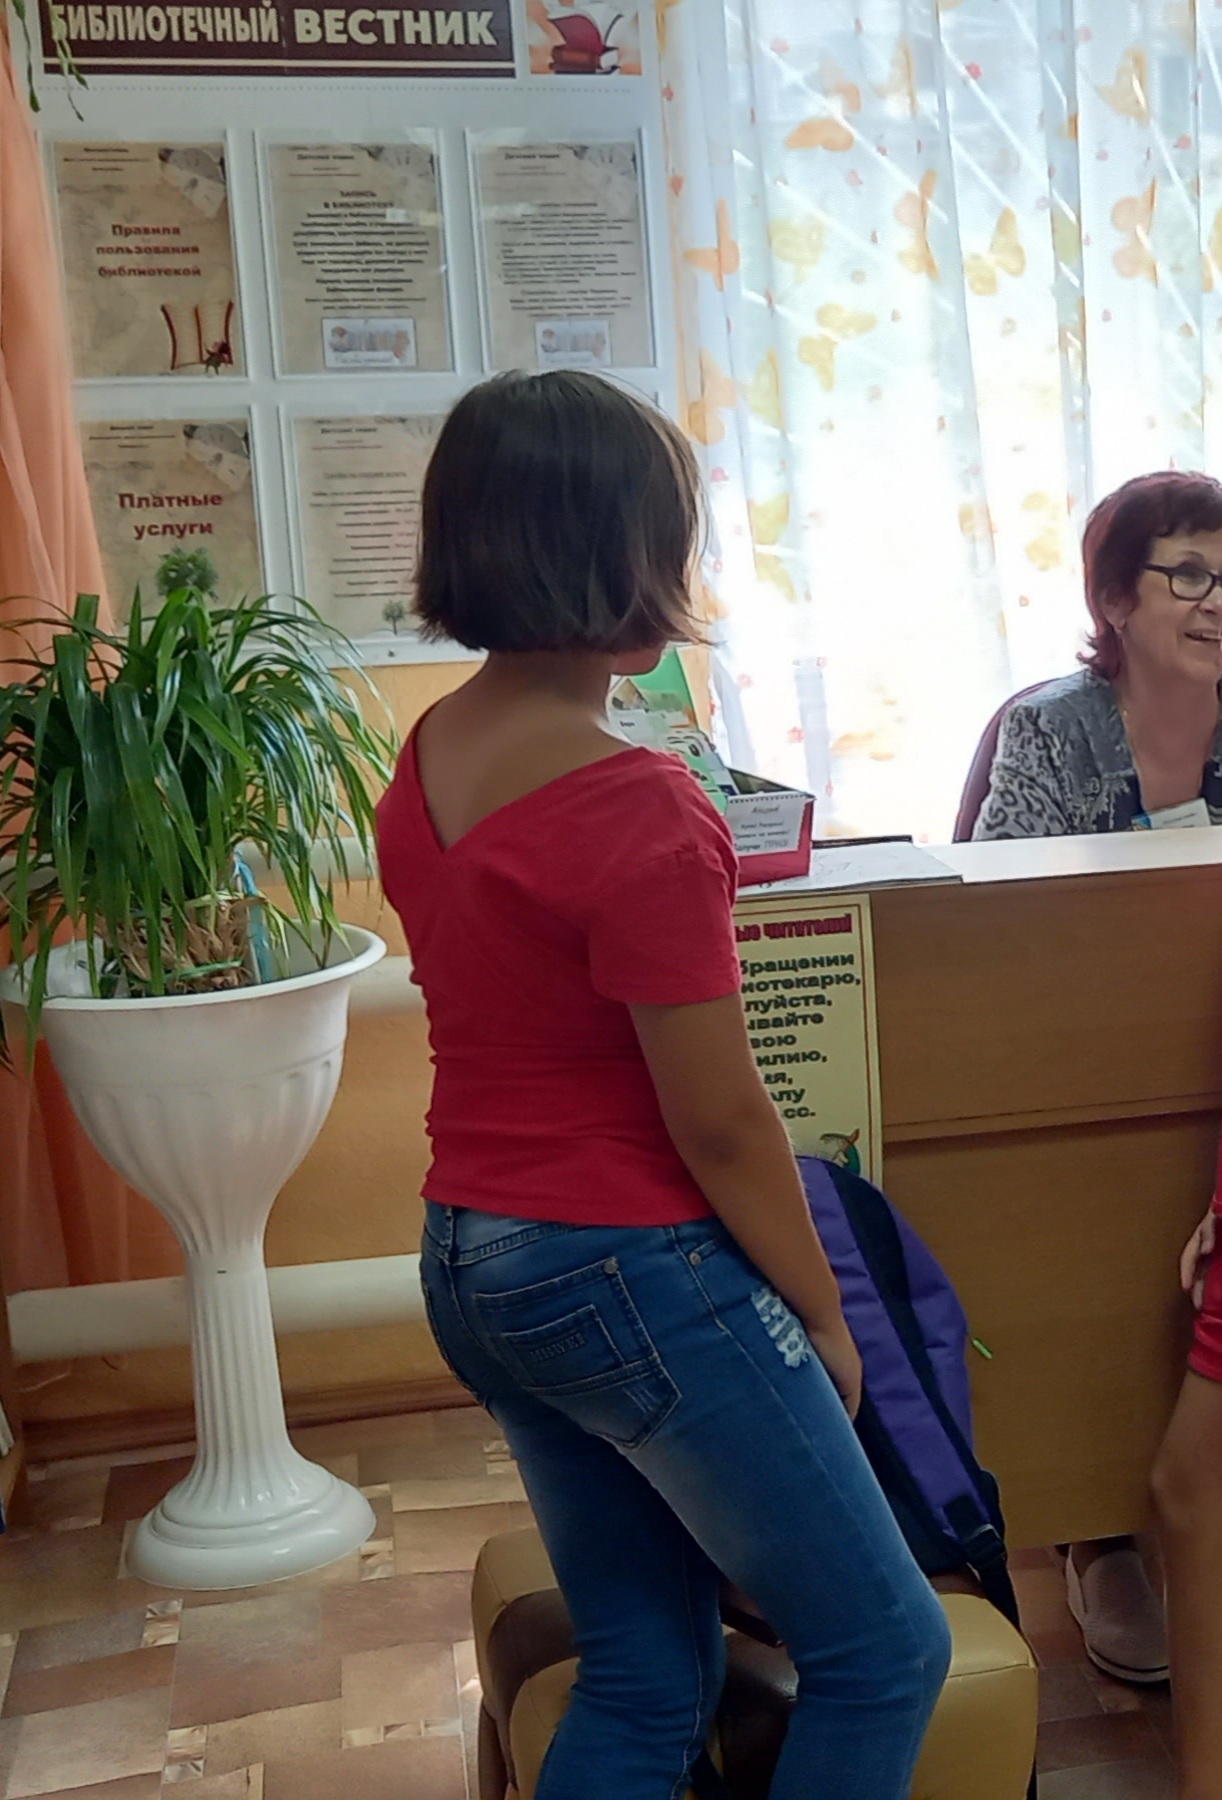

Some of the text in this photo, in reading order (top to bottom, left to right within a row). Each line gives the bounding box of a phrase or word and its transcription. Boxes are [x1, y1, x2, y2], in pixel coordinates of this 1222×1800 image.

[294, 8, 497, 46] ВЕСТНИК
[111, 224, 181, 237] Правила
[98, 266, 201, 277] библиотекой
[118, 493, 223, 509] Платные
[134, 523, 213, 540] услуги
[744, 994, 832, 1014] луйста,
